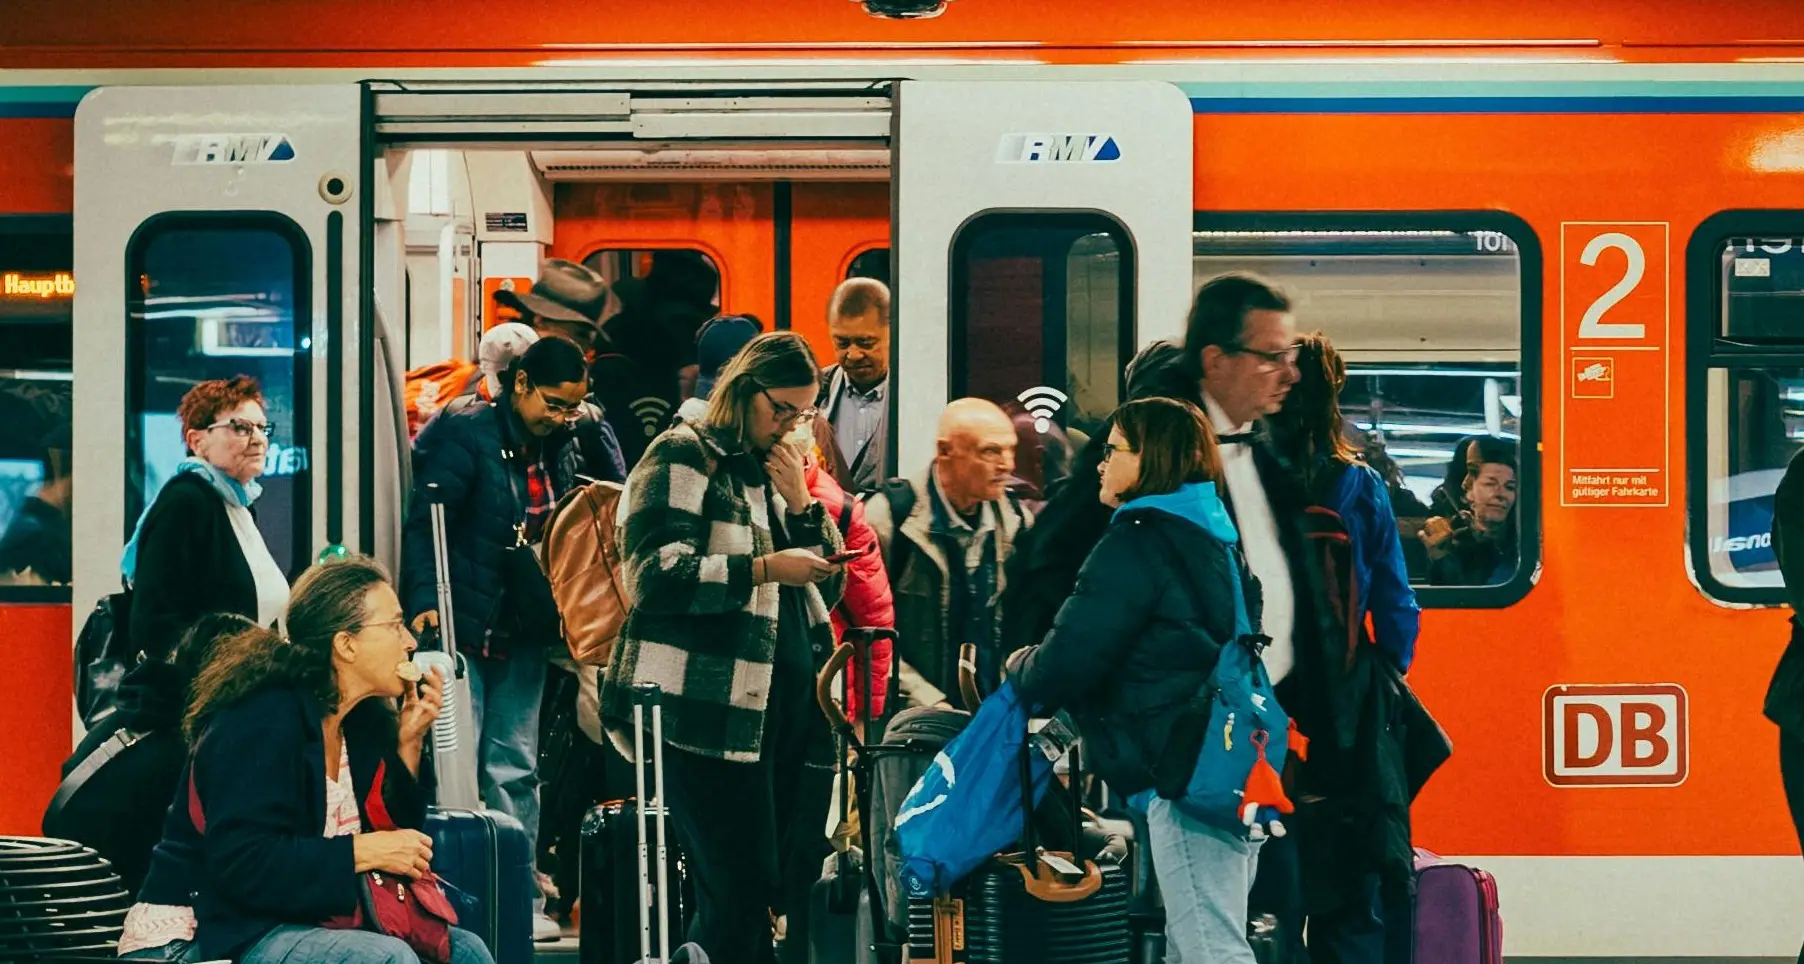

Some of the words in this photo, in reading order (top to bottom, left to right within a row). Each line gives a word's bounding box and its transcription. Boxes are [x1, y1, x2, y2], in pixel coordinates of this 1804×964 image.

[1020, 134, 1103, 161] RMV
[1578, 232, 1646, 339] 2
[1572, 475, 1611, 485] Mitfahrt
[1612, 476, 1630, 485] nur
[1631, 475, 1647, 485] mit
[1611, 486, 1659, 497] Fahrkarte
[1564, 702, 1669, 768] DB
